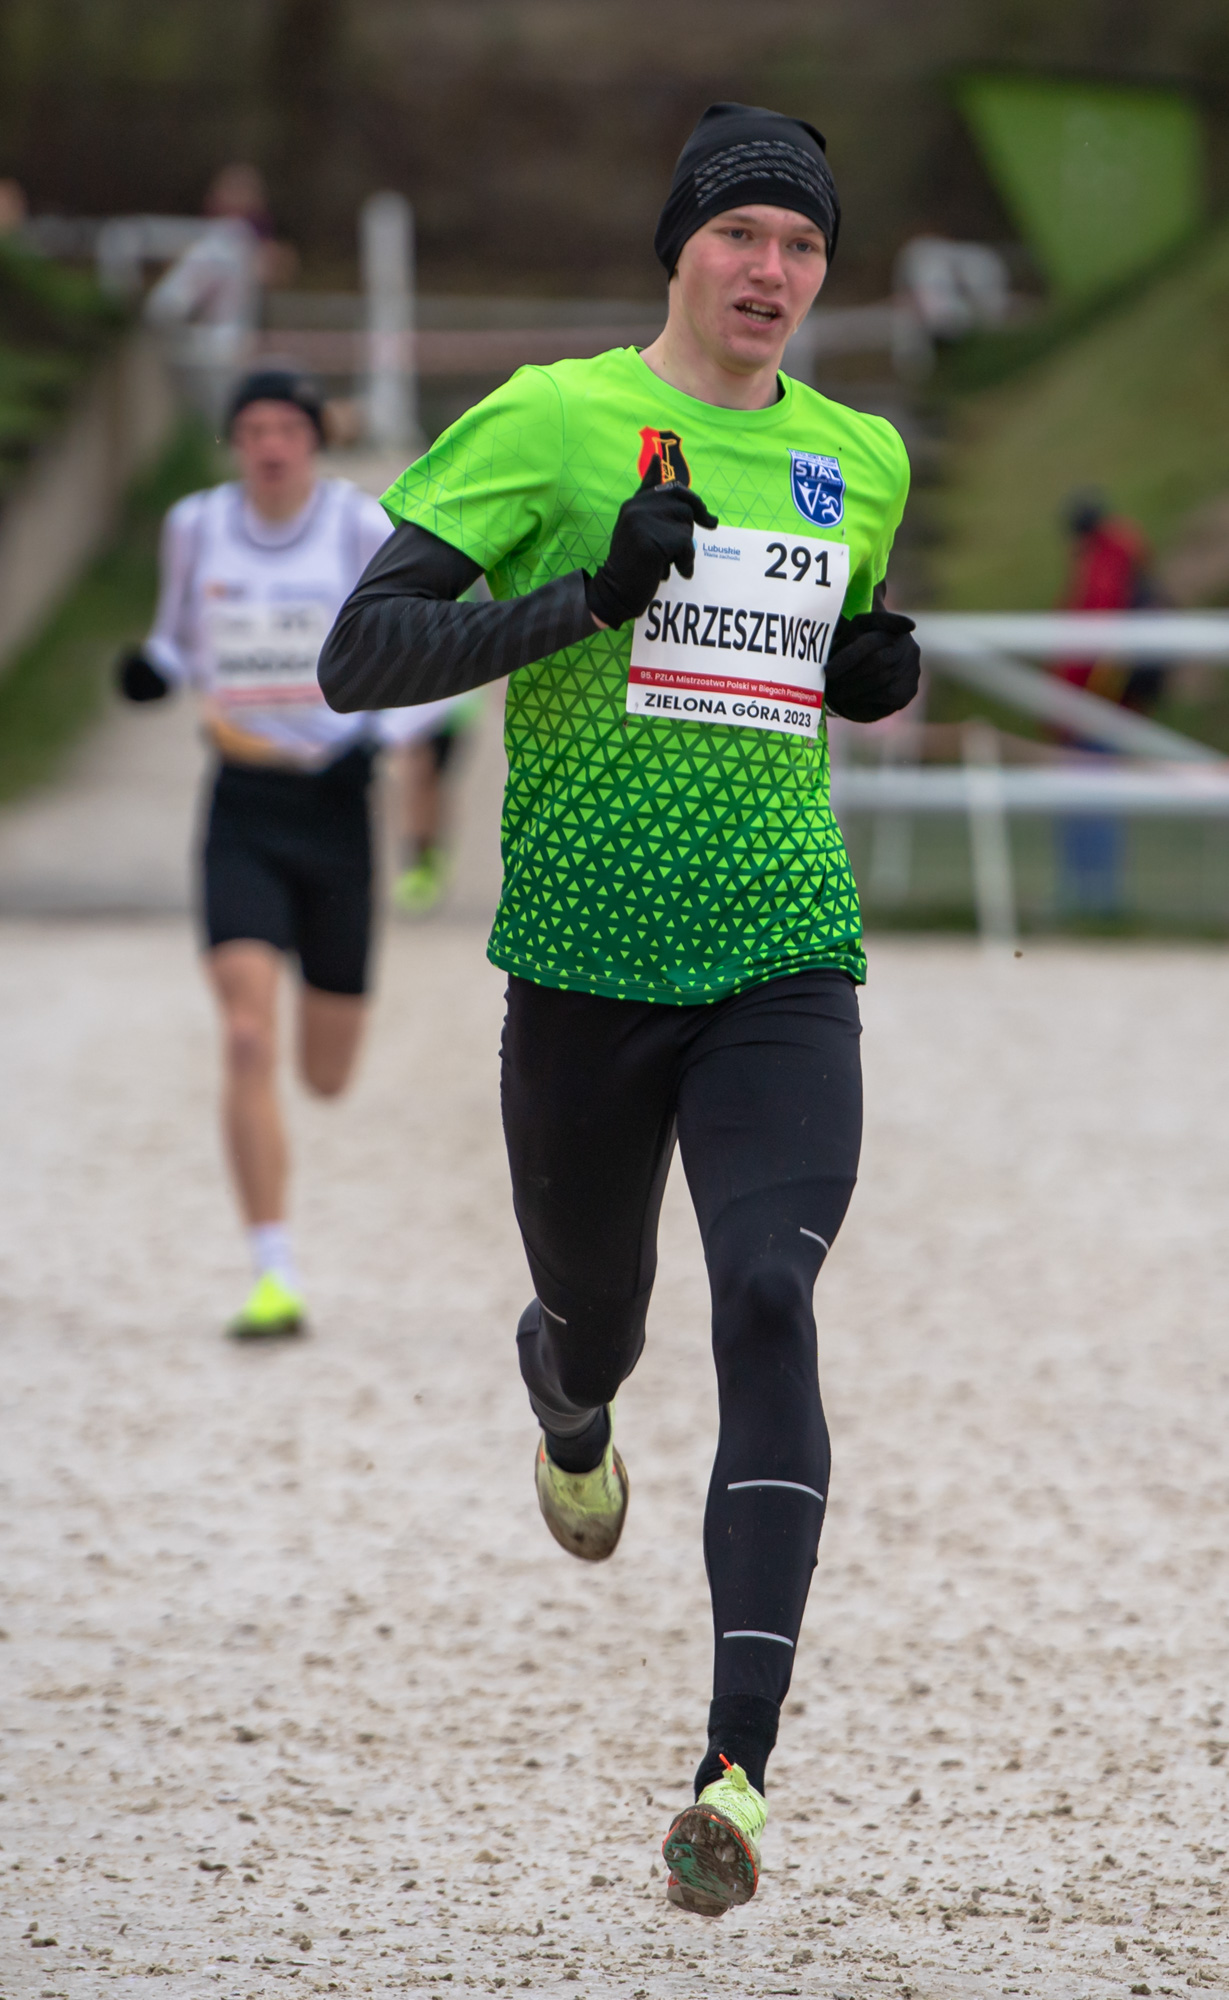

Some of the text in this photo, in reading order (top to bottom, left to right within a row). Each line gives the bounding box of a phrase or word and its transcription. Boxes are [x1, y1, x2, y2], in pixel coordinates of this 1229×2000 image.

[795, 460, 841, 482] STAL
[702, 542, 741, 556] Lubuskie
[764, 542, 831, 588] 291
[644, 599, 831, 664] SKRZESZEWSKI
[655, 672, 675, 683] PZLA
[676, 675, 726, 688] Mistrzostwa
[726, 680, 750, 691] Polski
[759, 684, 786, 697] Biegach
[644, 692, 812, 728] ZIELONA GÓRA 2023
